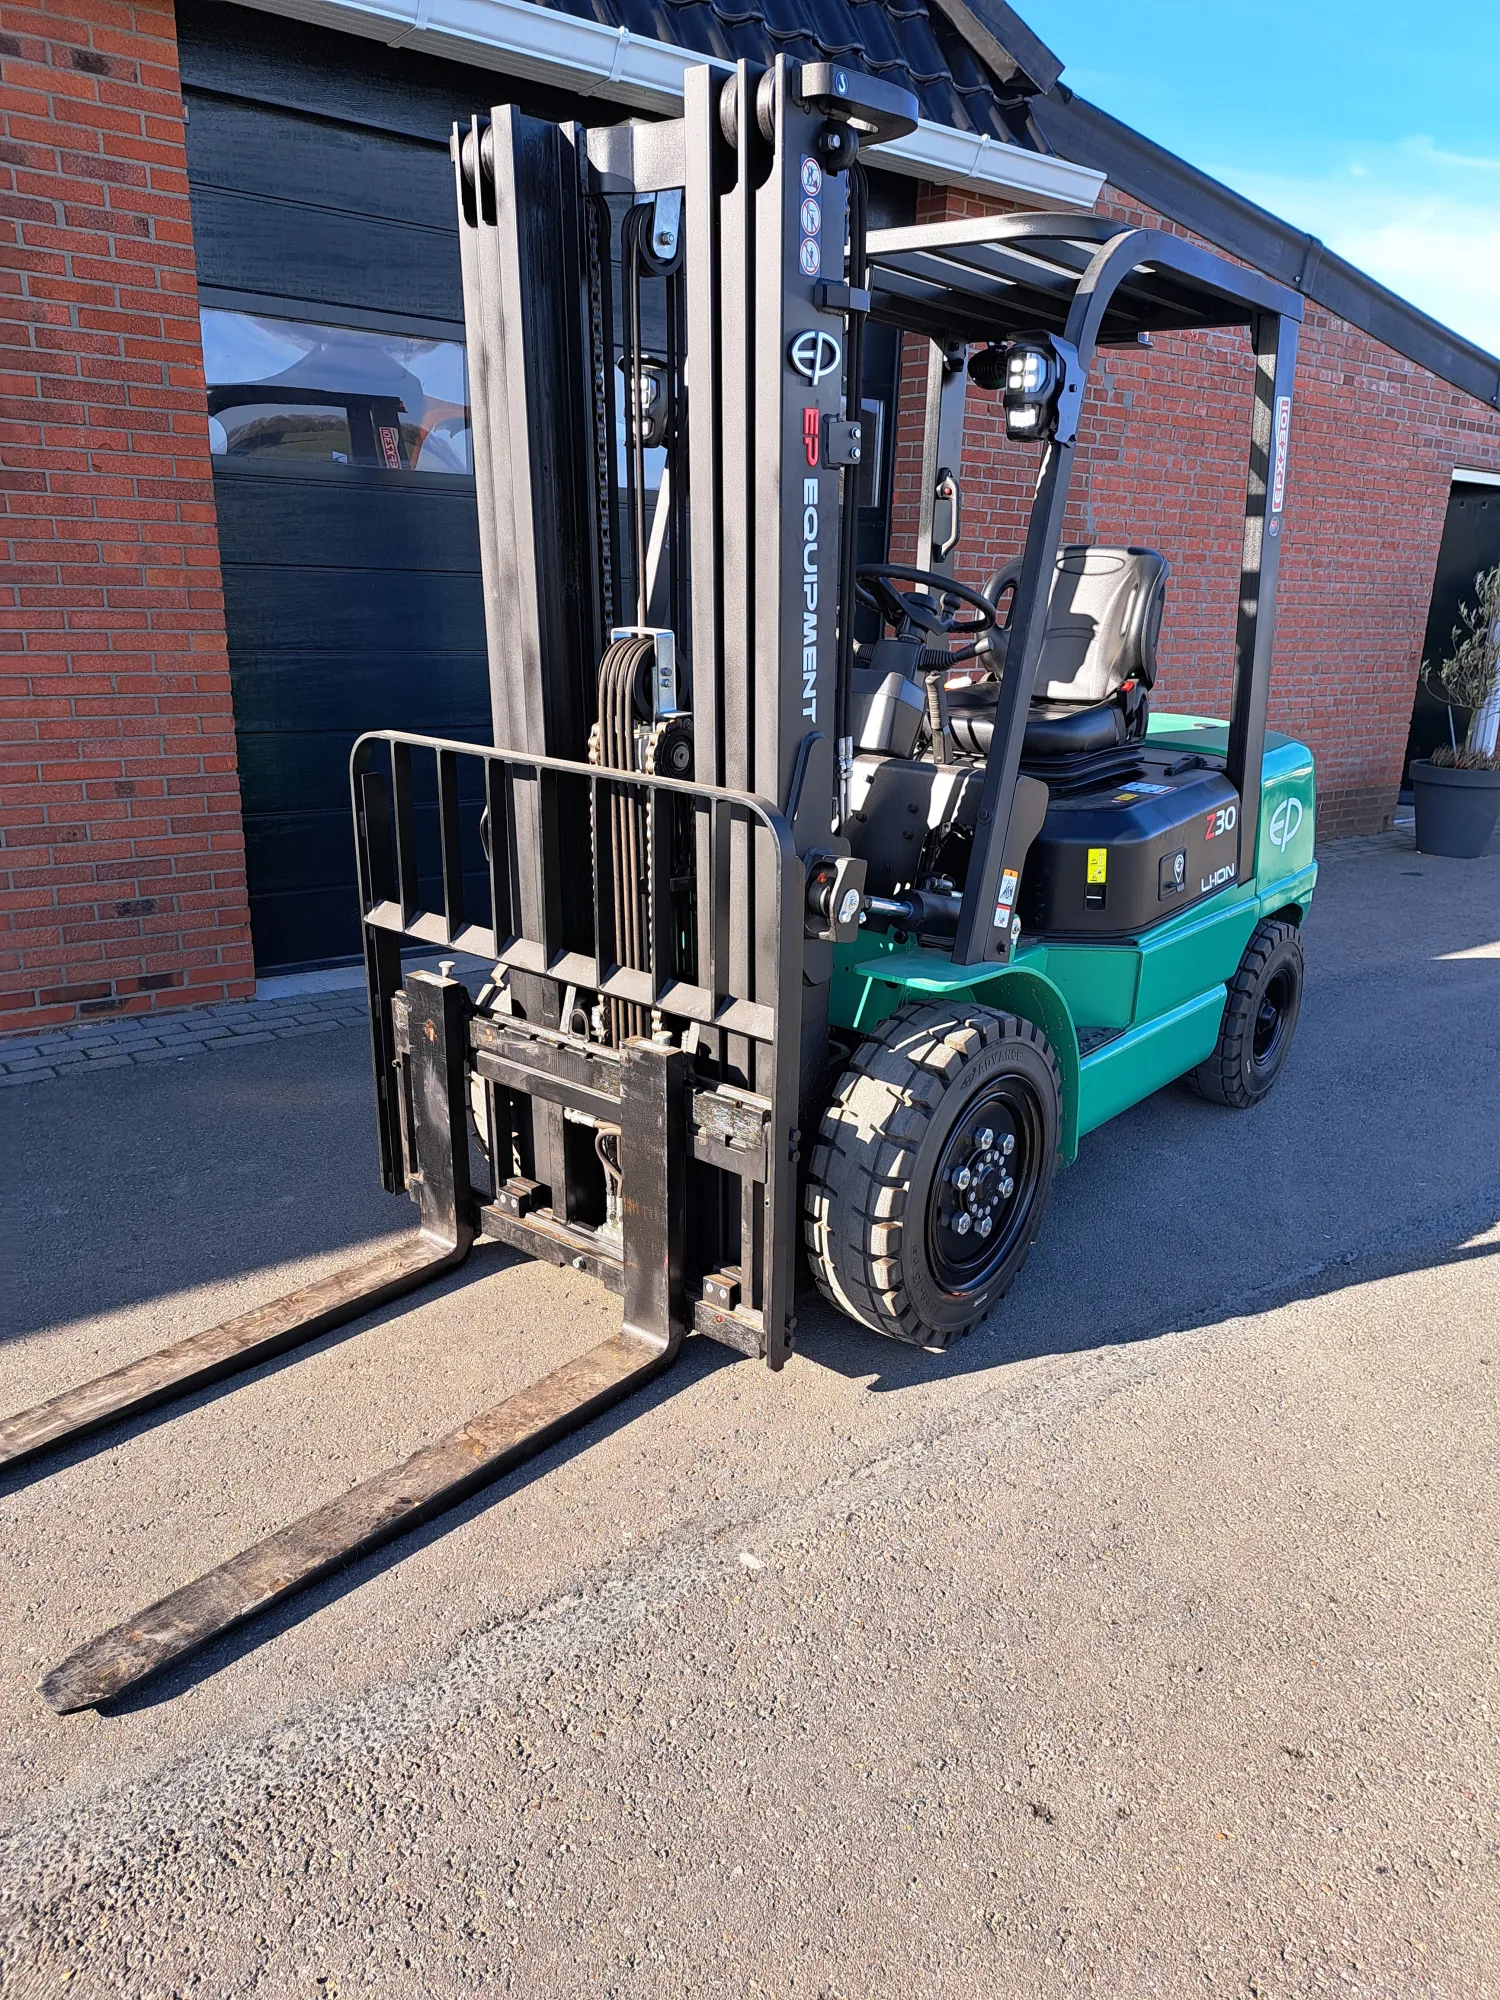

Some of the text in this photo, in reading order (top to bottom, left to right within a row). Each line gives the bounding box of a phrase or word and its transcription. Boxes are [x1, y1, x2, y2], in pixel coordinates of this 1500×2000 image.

[801, 407, 820, 724] EP EQUIPMENT
[1205, 805, 1236, 841] Z30
[1201, 862, 1235, 892] LI-ION
[978, 1048, 1023, 1075] ADVANCE
